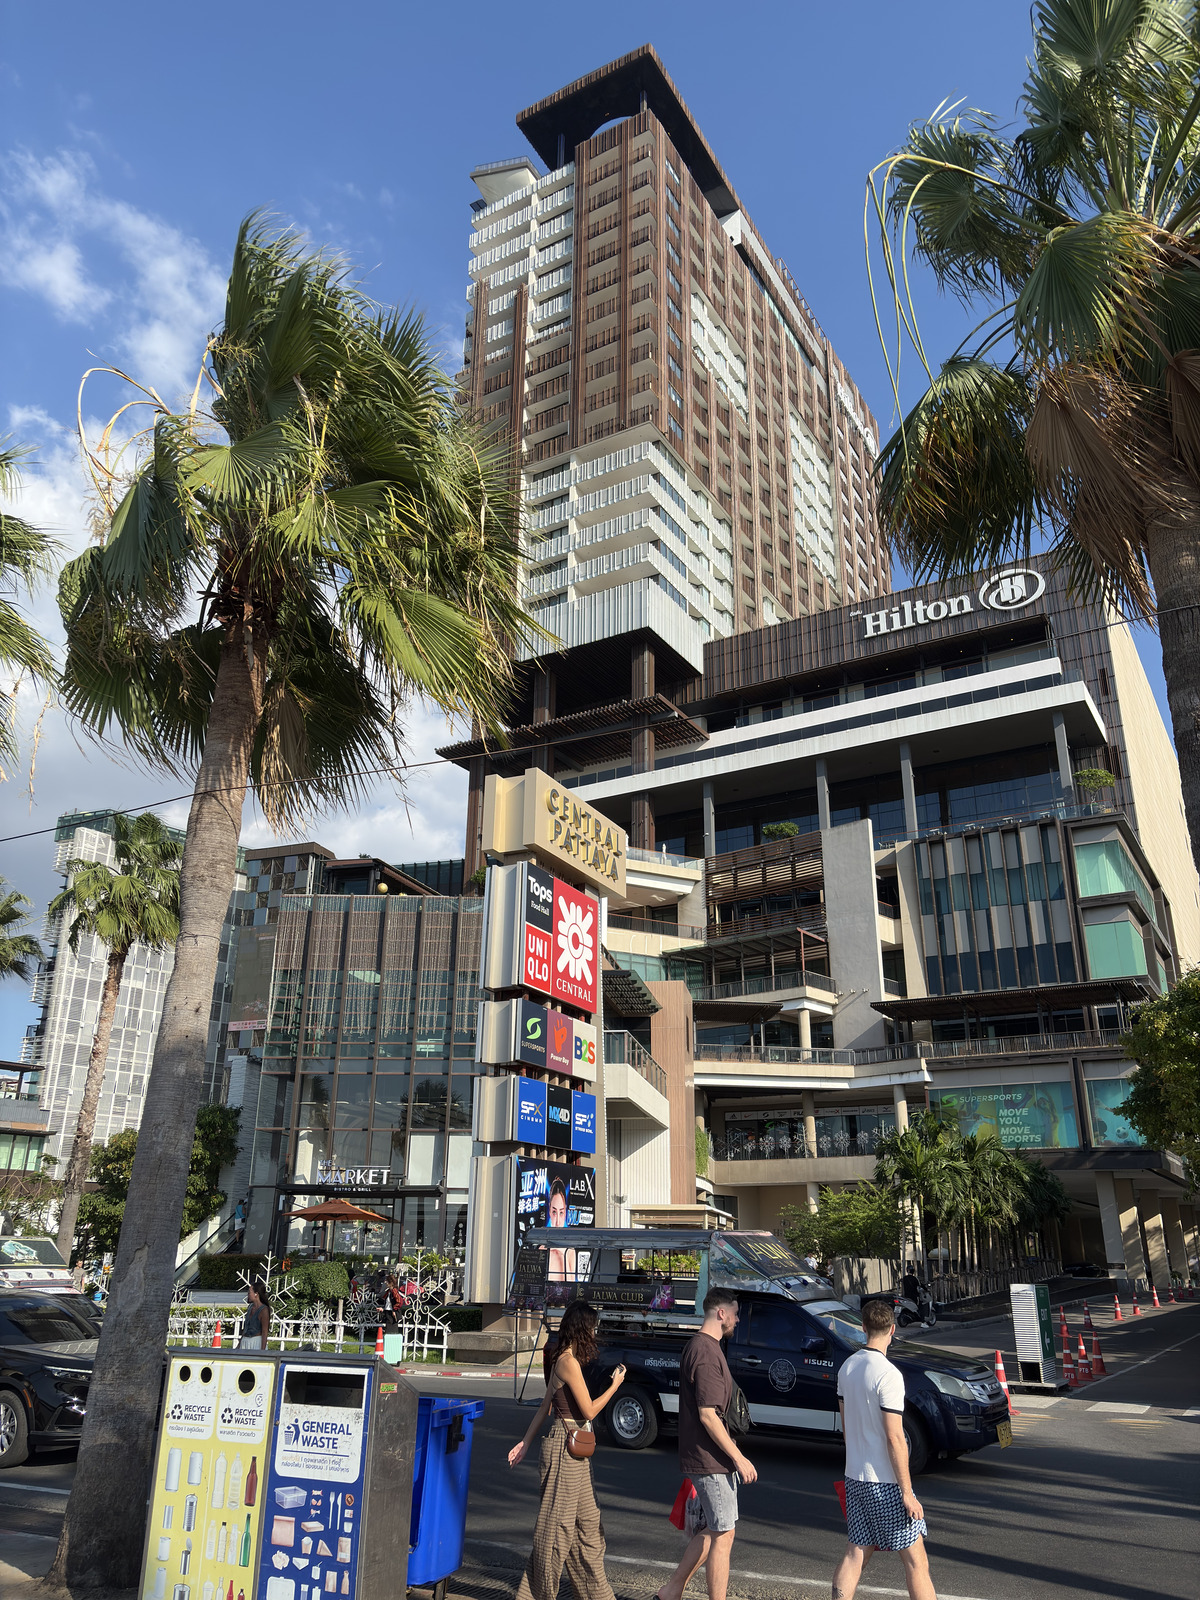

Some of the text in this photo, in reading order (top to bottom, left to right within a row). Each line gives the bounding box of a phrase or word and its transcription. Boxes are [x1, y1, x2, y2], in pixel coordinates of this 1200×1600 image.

[862, 594, 974, 639] Hilton
[547, 789, 622, 858] CENTRAL
[550, 819, 619, 883] PATTAYA
[528, 875, 553, 903] Tops
[530, 900, 550, 916] Food Hall
[528, 933, 548, 960] UNI
[527, 957, 549, 982] QLO
[556, 977, 593, 1003] CENTRAL
[521, 1040, 546, 1054] SUPERSPORTS
[574, 1035, 596, 1065] B2S
[550, 1053, 562, 1062] Power
[959, 1093, 1022, 1103] SUPERSPORTS
[998, 1107, 1029, 1117] MOVE
[999, 1117, 1023, 1126] YOU,
[1000, 1126, 1031, 1135] MOVE
[1001, 1134, 1042, 1144] SPORTS
[316, 1169, 391, 1185] MARKET
[519, 1167, 548, 1198] 亚洲
[517, 1196, 546, 1215] 排名第一
[519, 1264, 542, 1274] JALWA
[592, 1290, 644, 1302] JALWA CLUB
[808, 1359, 834, 1368] ISUZU
[184, 1405, 212, 1414] RECYCLE
[234, 1408, 264, 1418] RECYCLE
[184, 1413, 205, 1422] WASTE
[234, 1417, 257, 1426] WASTE
[302, 1420, 353, 1436] GENERAL
[301, 1434, 339, 1450] WASTE
